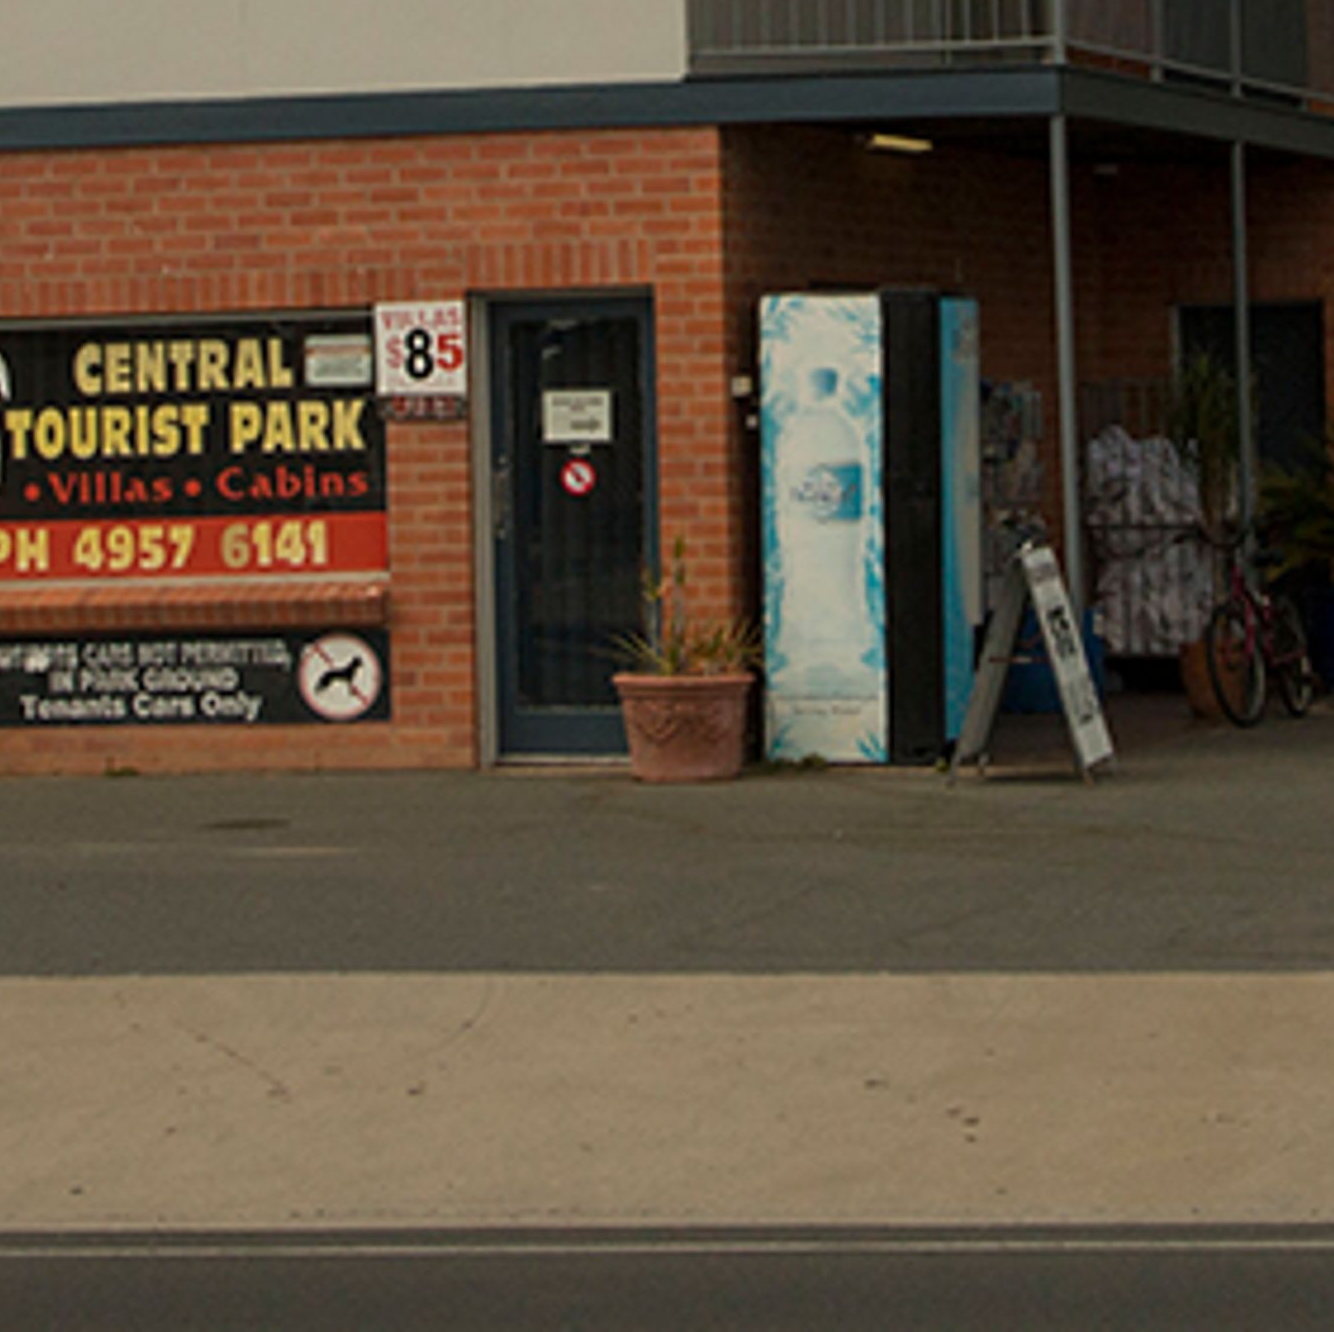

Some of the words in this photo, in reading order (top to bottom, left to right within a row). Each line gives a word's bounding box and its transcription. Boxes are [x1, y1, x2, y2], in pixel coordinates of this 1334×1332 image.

[74, 338, 293, 395] CENTRAL
[5, 404, 209, 458] TOURIST
[230, 400, 365, 452] PARK
[48, 471, 172, 505] Villas
[216, 465, 369, 501] Cabins
[73, 525, 193, 569] 4957
[221, 521, 328, 567] 6141
[80, 668, 139, 691] PARK
[19, 694, 126, 719] Tenants
[132, 694, 196, 718] Cars
[200, 692, 263, 721] Only
